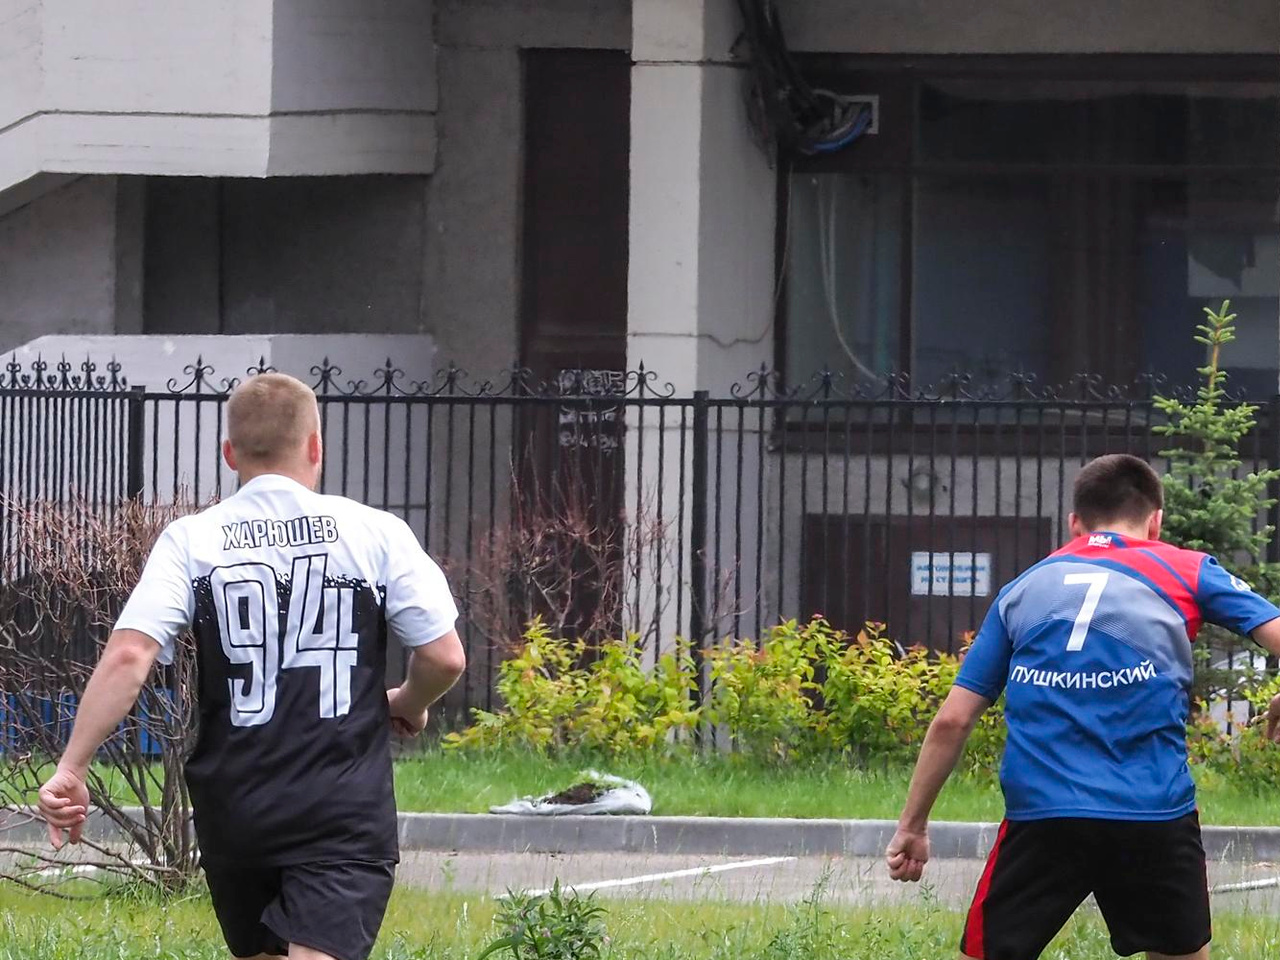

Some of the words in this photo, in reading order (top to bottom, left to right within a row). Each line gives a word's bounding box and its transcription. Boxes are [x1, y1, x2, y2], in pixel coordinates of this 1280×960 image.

[223, 516, 338, 550] ХАРЮШЕВ
[1063, 572, 1109, 651] 7
[209, 553, 359, 727] 94
[1011, 659, 1157, 688] ПУШКИНСКИЙ
